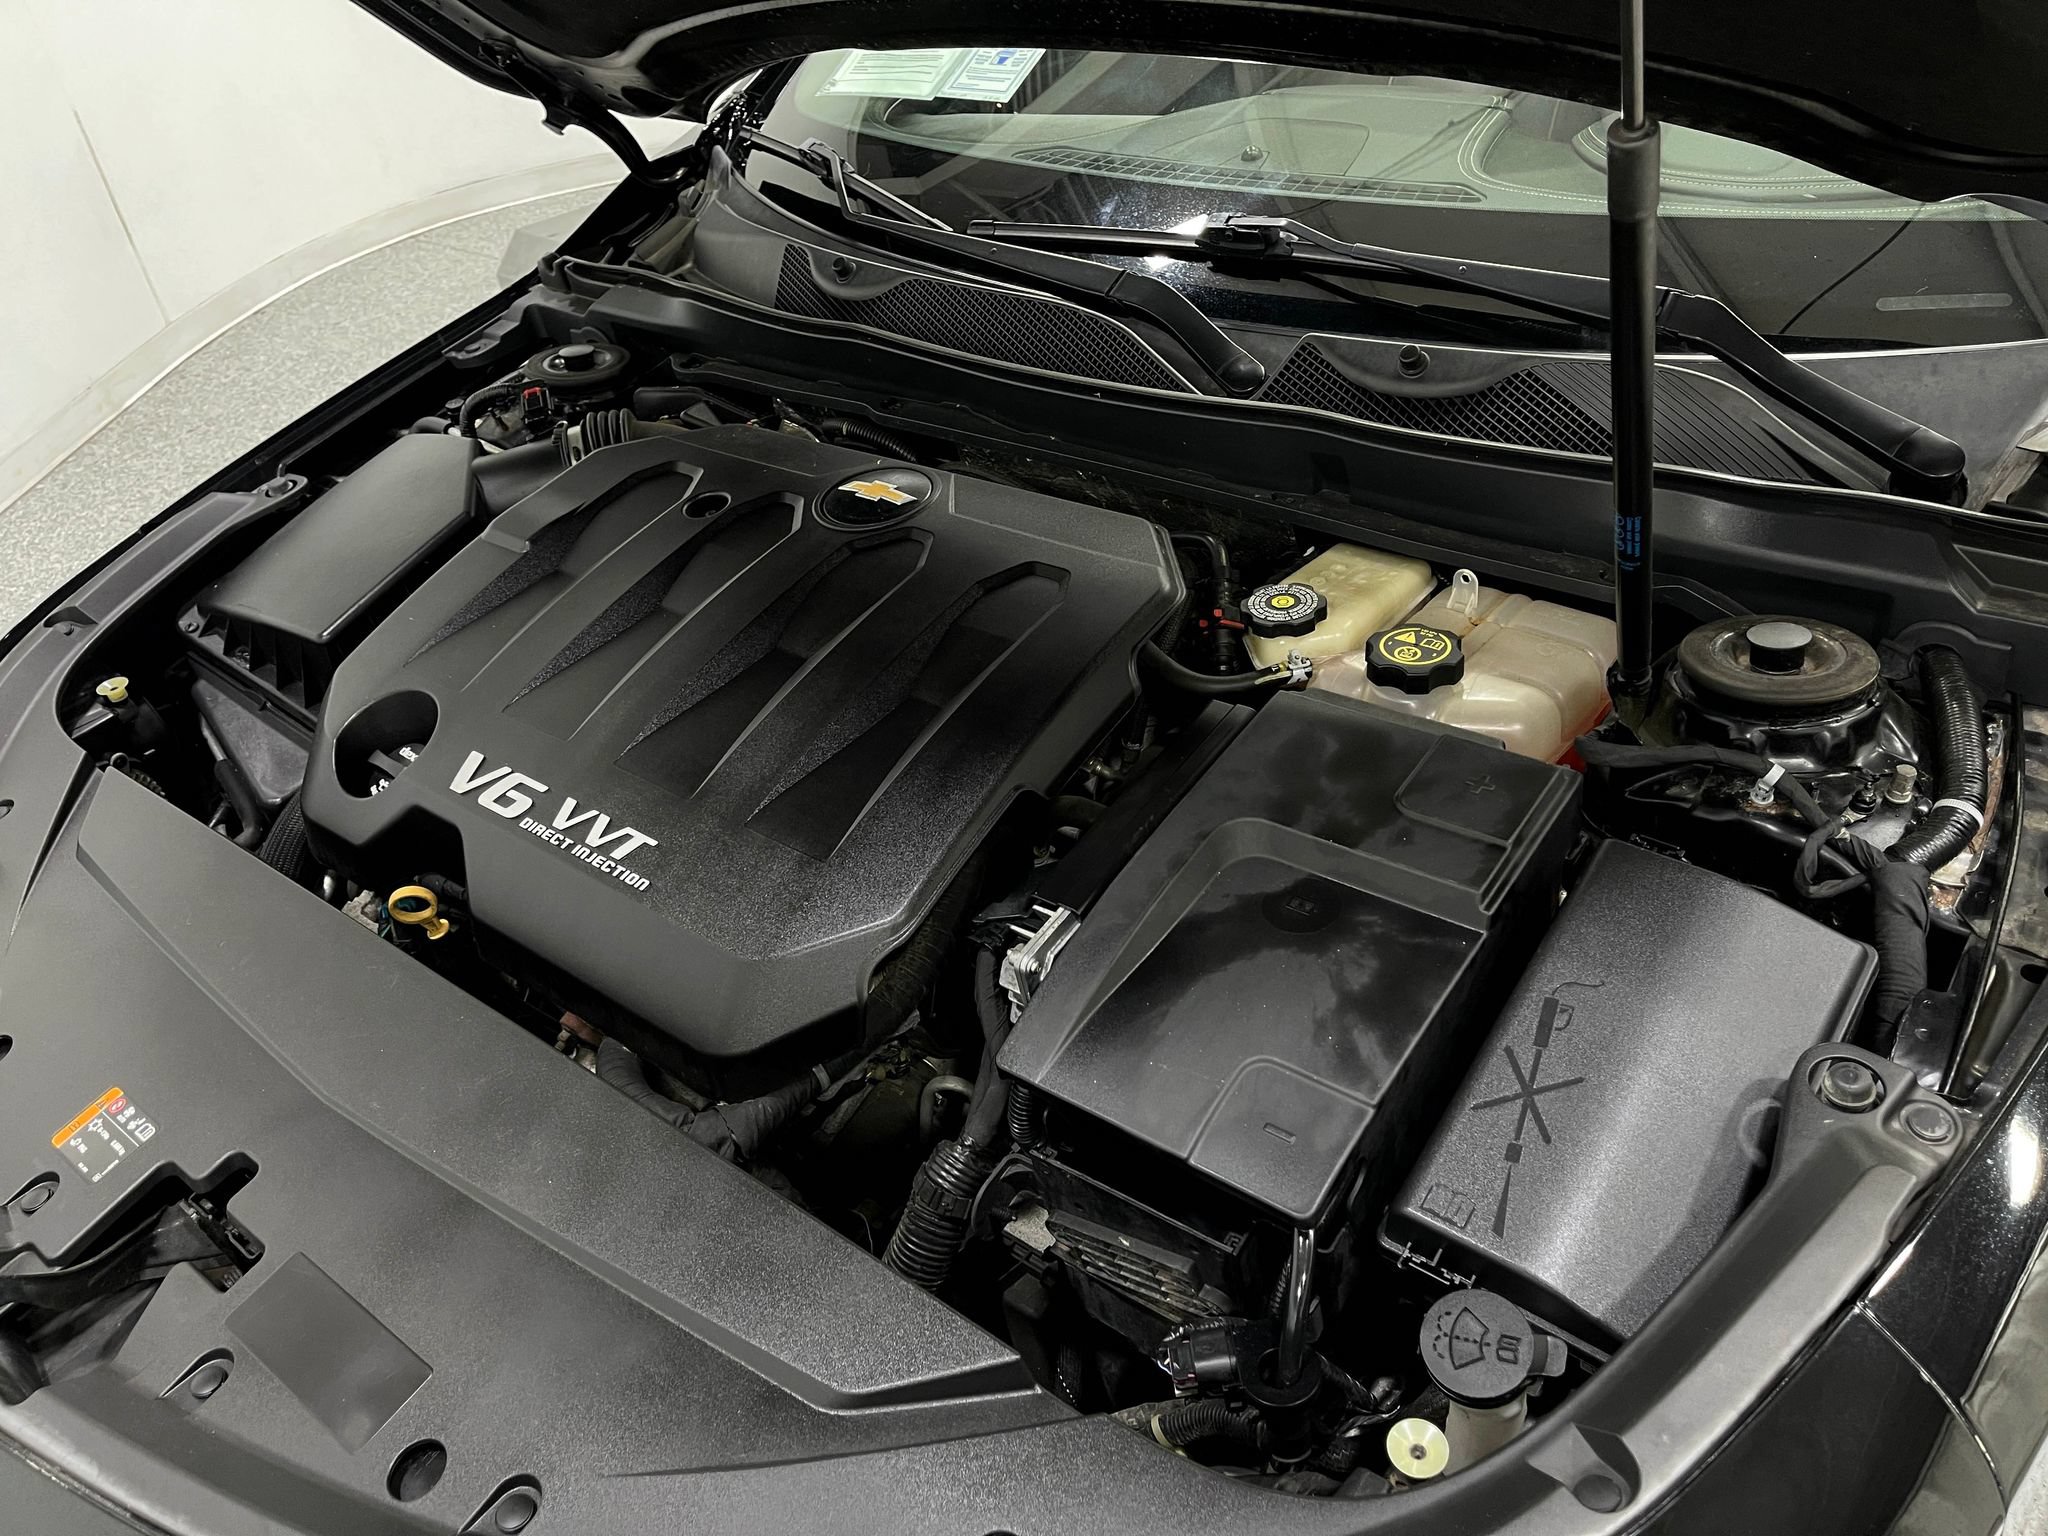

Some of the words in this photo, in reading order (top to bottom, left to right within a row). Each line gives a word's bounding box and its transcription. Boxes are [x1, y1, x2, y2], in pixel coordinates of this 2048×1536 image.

[449, 750, 549, 819] V6
[552, 796, 659, 861] VVT
[518, 817, 575, 850] DIRECT
[570, 844, 651, 892] INJECTION
